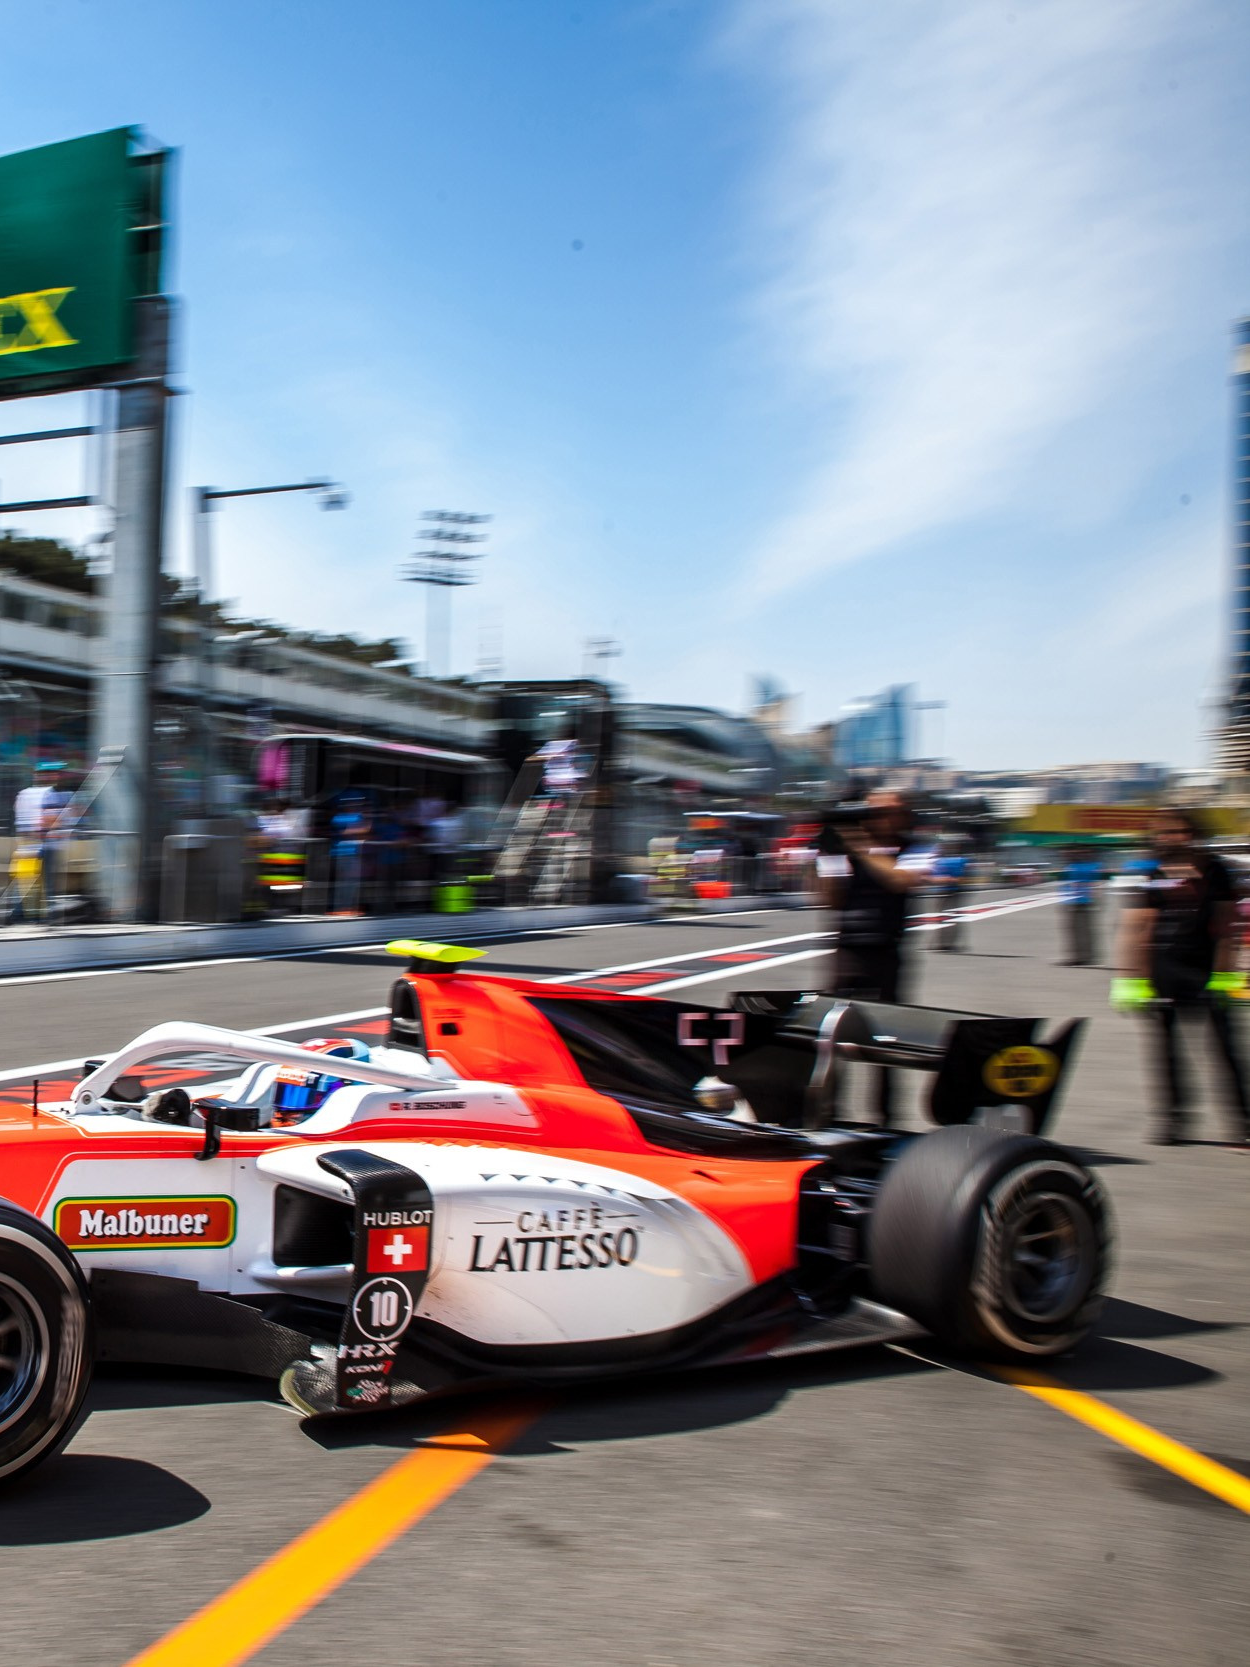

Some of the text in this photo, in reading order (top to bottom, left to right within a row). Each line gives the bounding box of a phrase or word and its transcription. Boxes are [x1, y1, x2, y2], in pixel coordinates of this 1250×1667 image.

[78, 1209, 209, 1238] Malbuner
[362, 1209, 434, 1226] HUBLOT
[468, 1226, 639, 1272] LATTESSO
[369, 1290, 399, 1327] 10
[336, 1340, 400, 1359] HRX
